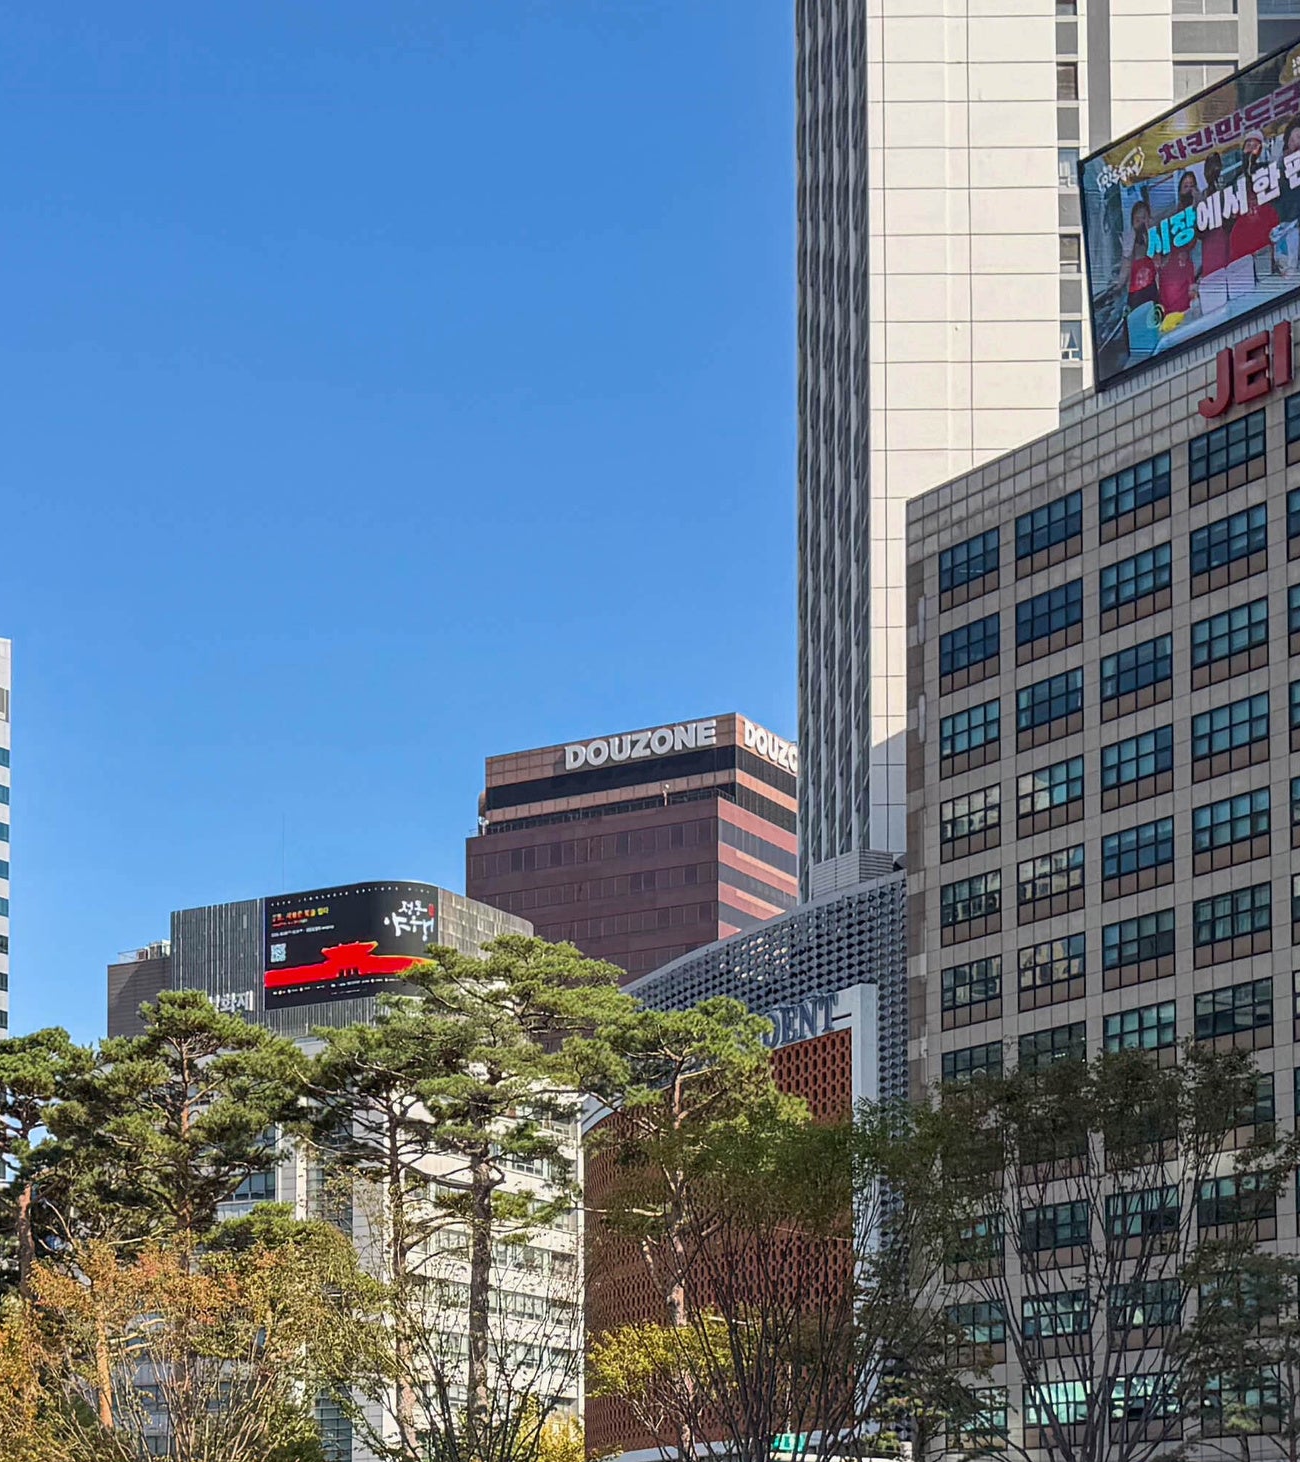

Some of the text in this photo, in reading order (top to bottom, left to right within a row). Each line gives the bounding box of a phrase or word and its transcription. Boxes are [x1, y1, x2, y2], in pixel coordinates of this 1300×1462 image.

[1146, 178, 1249, 259] 시장에서
[1252, 160, 1281, 207] 한
[1198, 319, 1293, 419] JEI
[564, 719, 718, 771] DOUZONE
